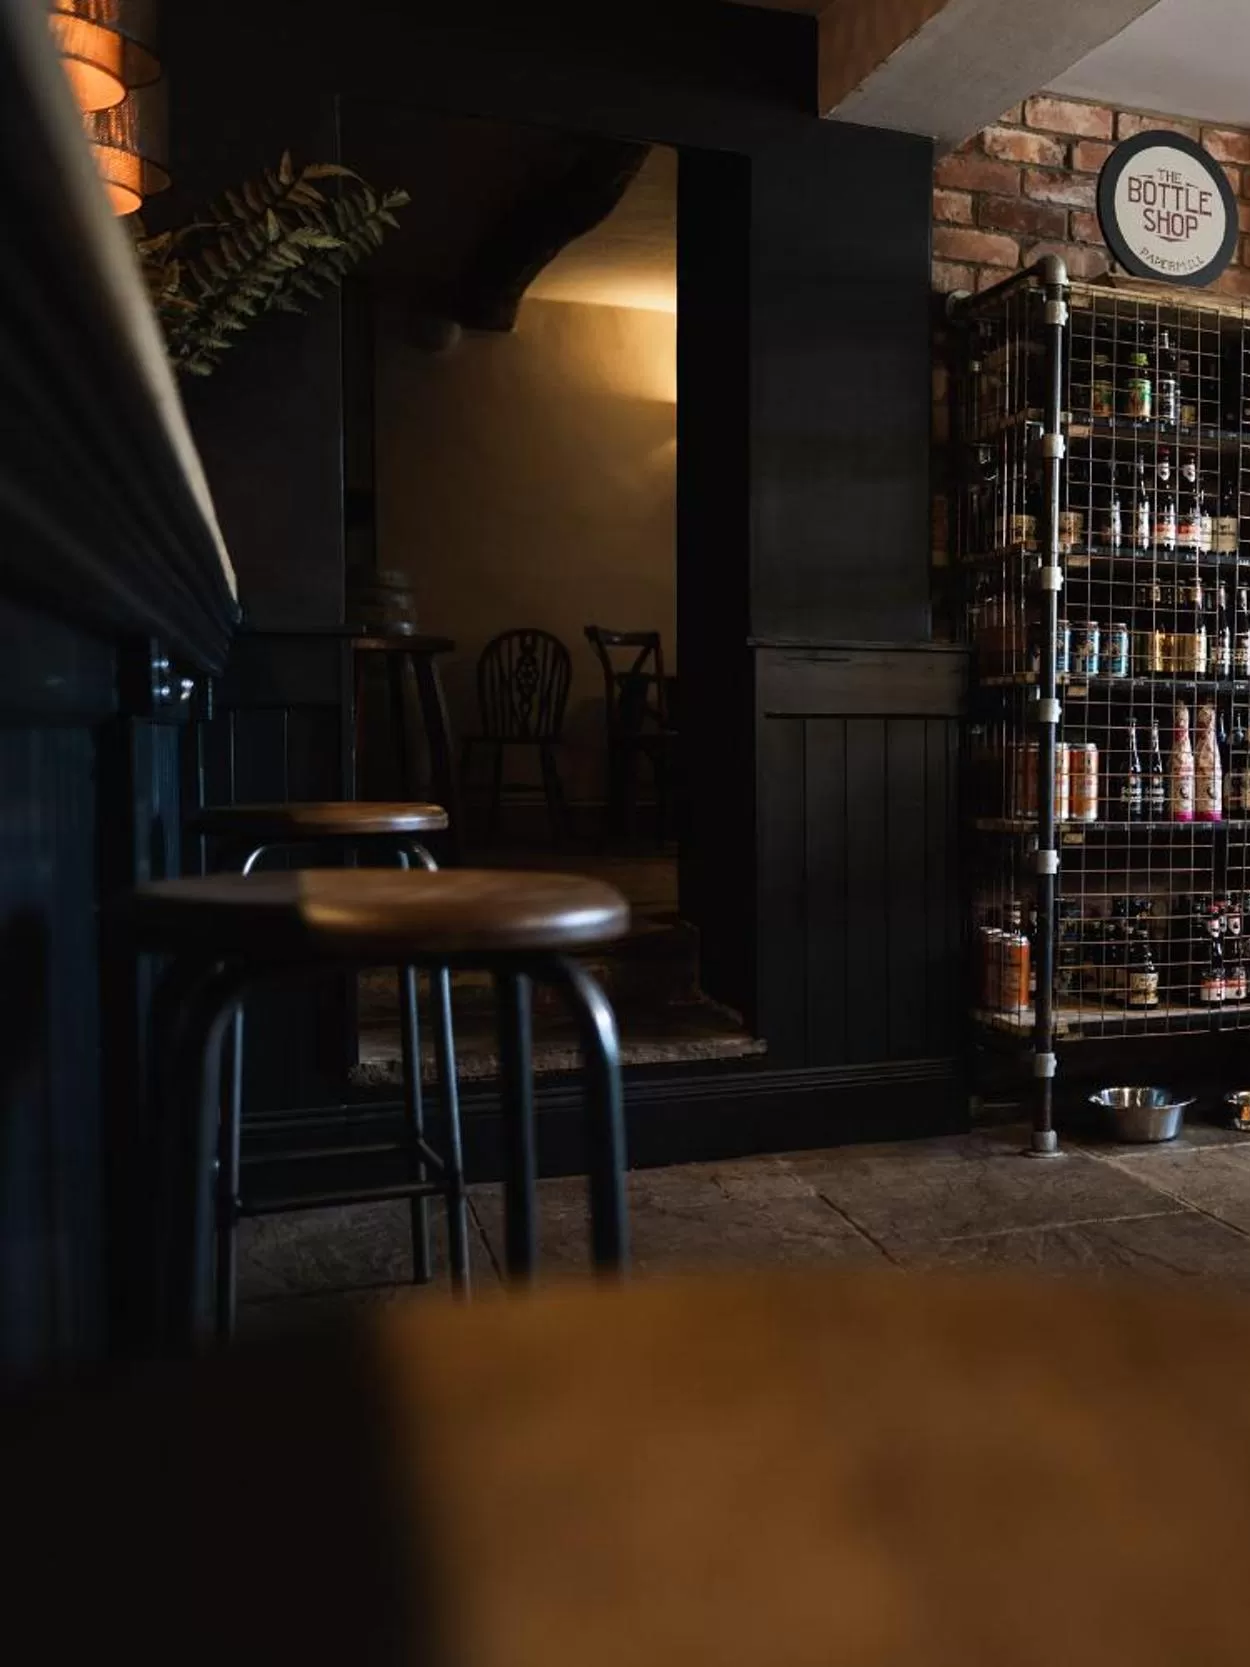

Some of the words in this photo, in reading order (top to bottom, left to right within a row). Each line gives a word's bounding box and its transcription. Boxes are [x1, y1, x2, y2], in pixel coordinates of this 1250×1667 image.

[1157, 167, 1182, 185] THE
[1128, 176, 1213, 217] BOTTLE
[1143, 208, 1199, 239] SHOP
